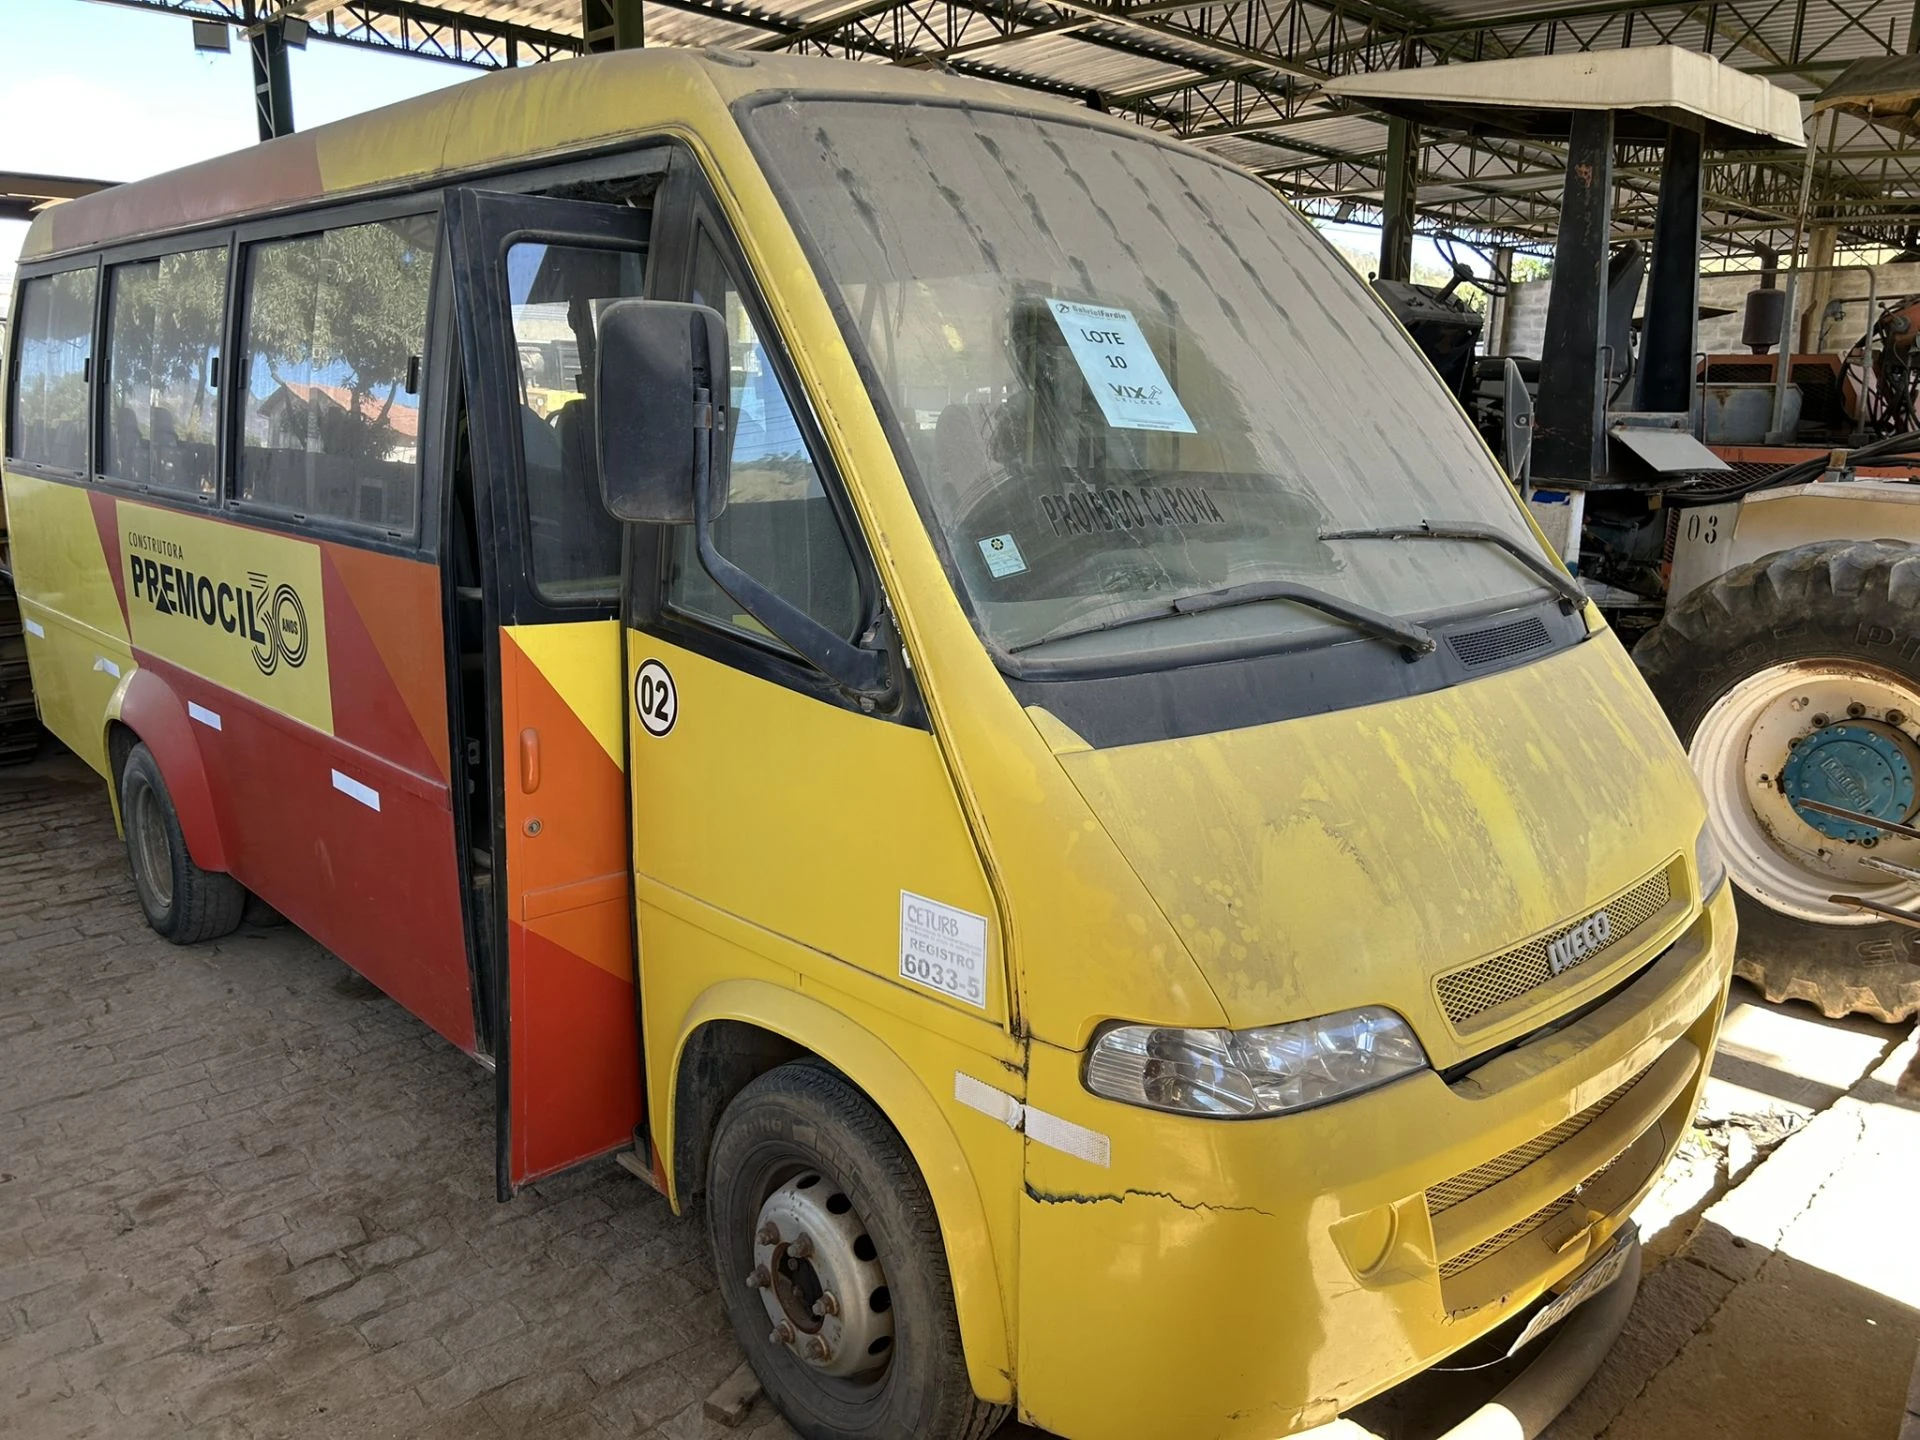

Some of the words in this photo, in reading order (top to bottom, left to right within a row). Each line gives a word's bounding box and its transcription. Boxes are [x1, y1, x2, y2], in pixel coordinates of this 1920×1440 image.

[1081, 328, 1125, 345] LOTE
[1105, 355, 1127, 369] 10
[1108, 383, 1147, 399] VIX
[1039, 488, 1146, 537] PROIBIDO
[1140, 487, 1226, 527] CARONA
[128, 532, 184, 560] CONSTRUTORA
[130, 554, 266, 646] PREMOCIL
[282, 618, 298, 636] ANOS
[641, 675, 669, 722] 02
[907, 905, 959, 937] CETURB
[910, 938, 975, 970] REGISTRO
[1547, 911, 1611, 975] IVECO
[904, 954, 980, 999] 6033-5
